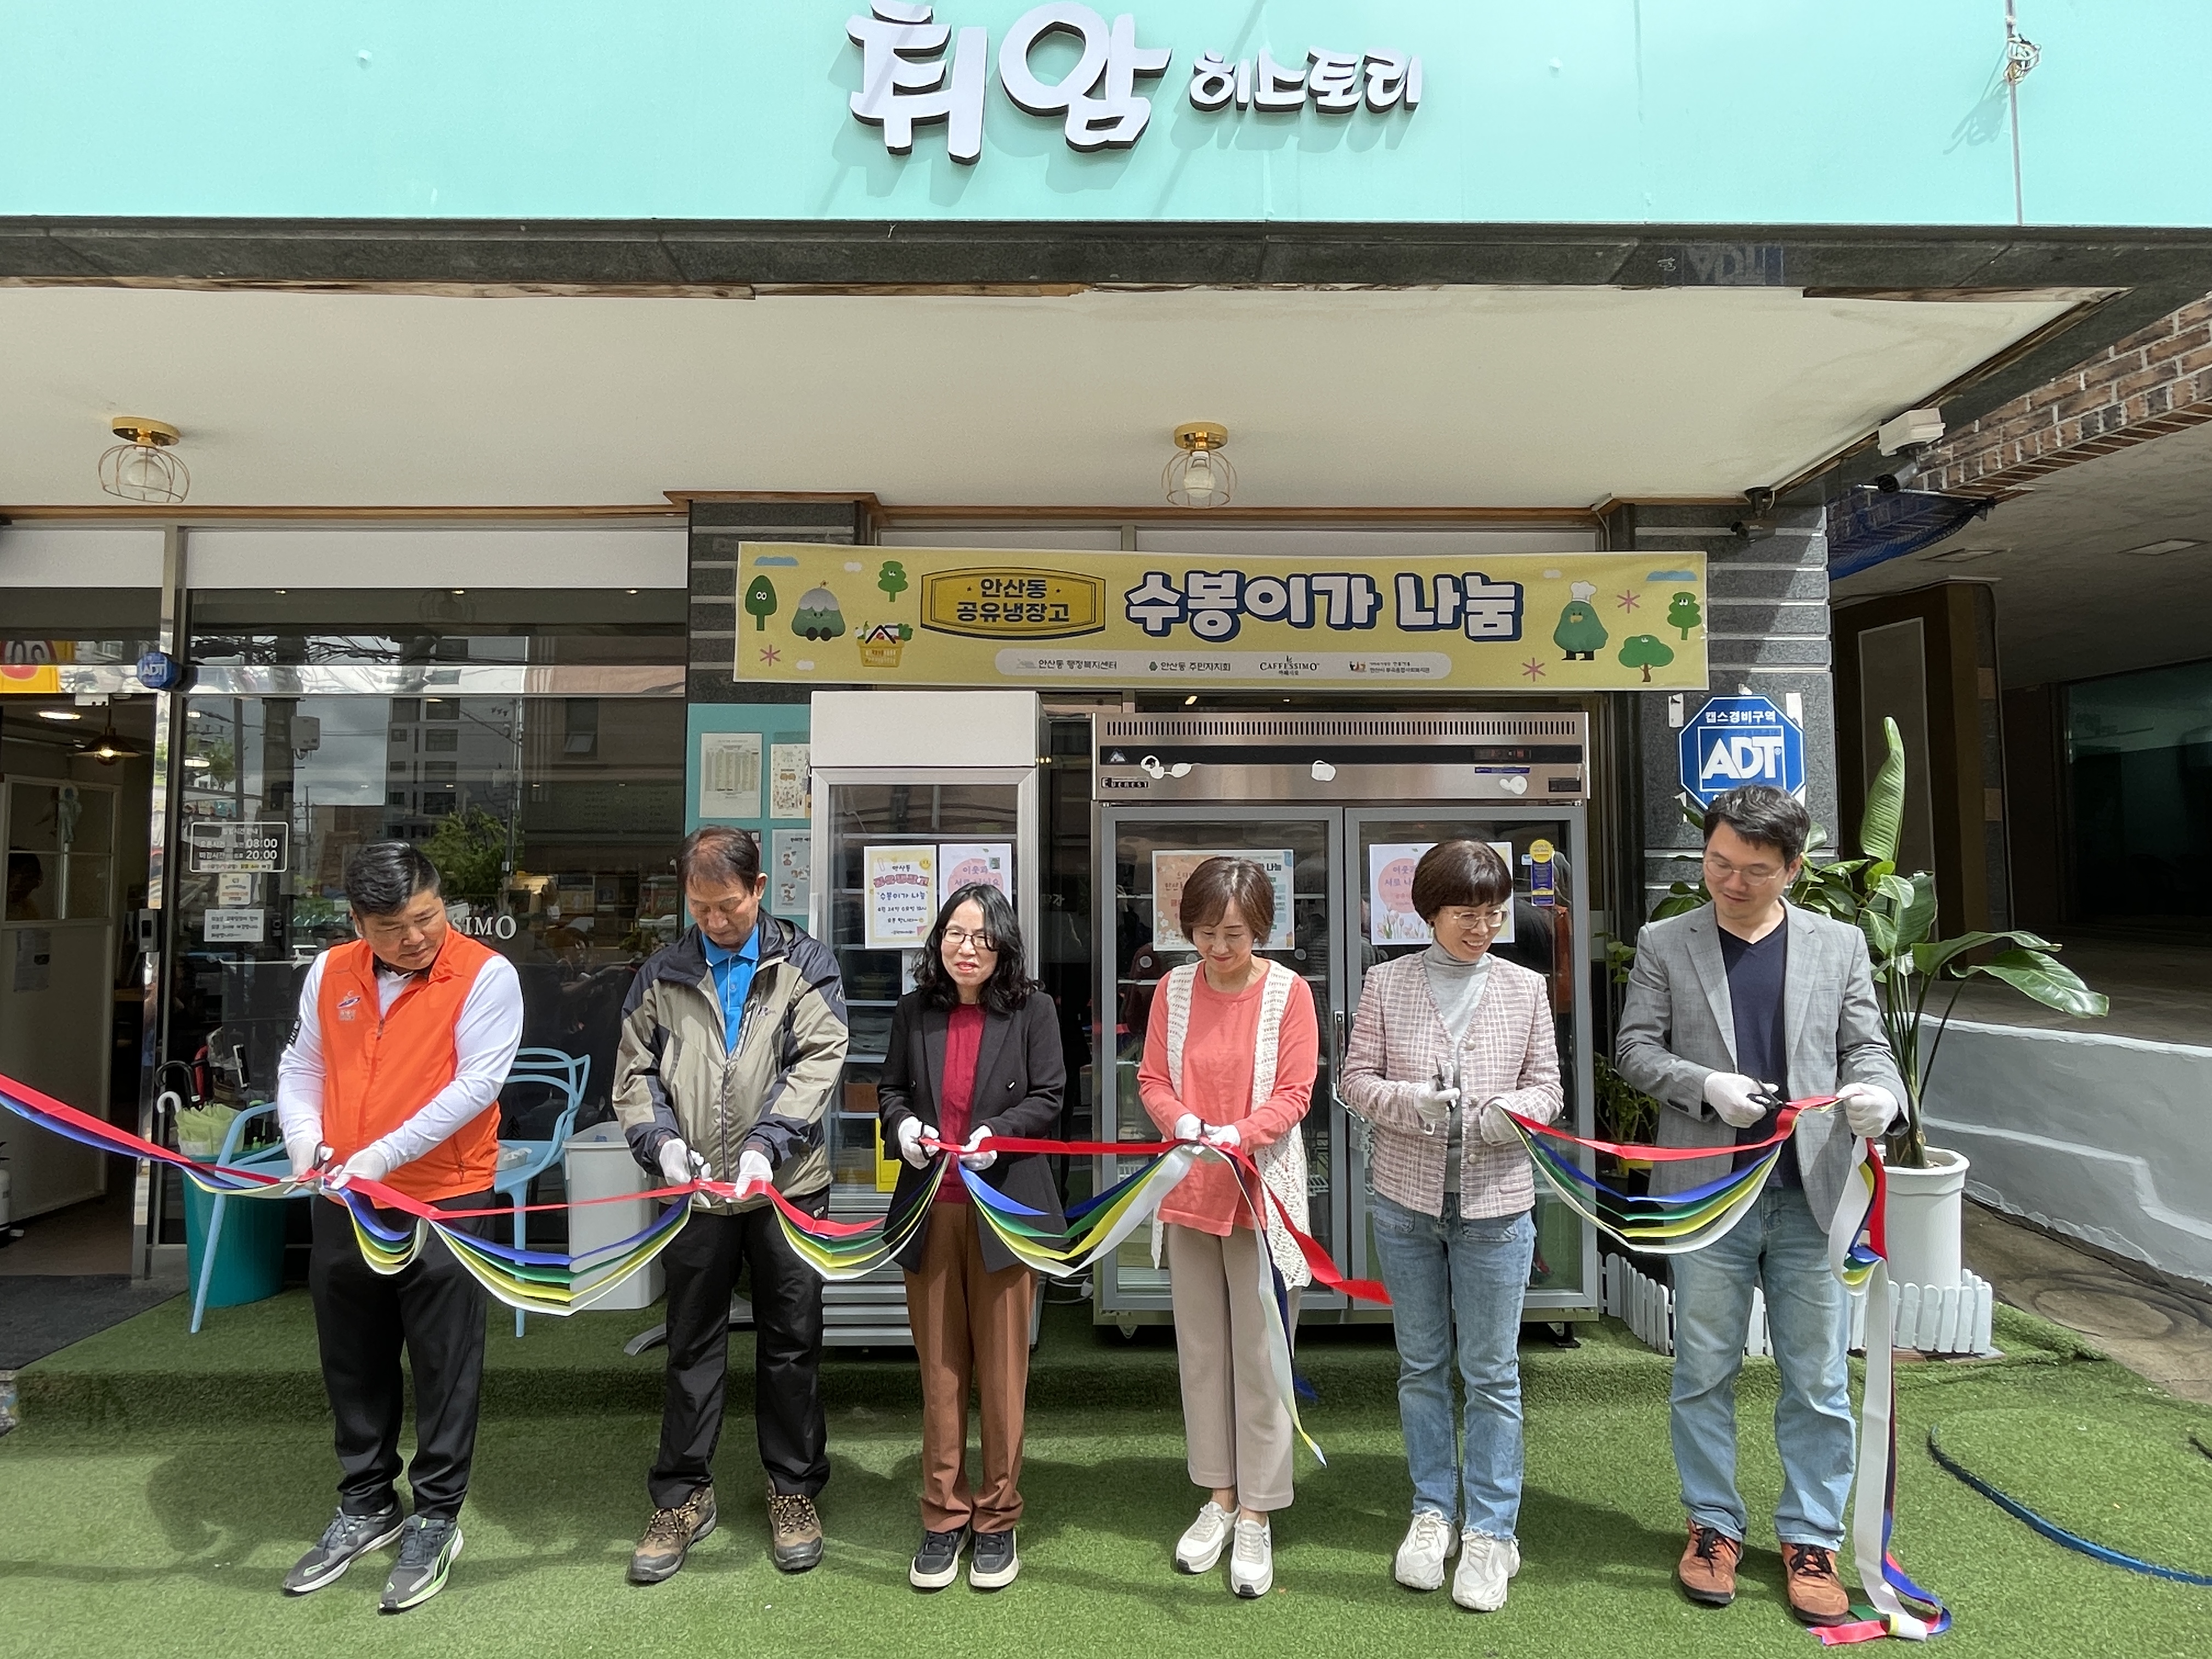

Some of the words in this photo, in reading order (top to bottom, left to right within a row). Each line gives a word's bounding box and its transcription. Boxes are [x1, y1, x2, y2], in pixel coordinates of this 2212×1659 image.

[1189, 46, 1423, 113] 히스토리
[980, 578, 1048, 599] 안산동
[956, 602, 1070, 624] 공유냉장고
[1125, 570, 1383, 642] 수봉이가
[1395, 573, 1524, 642] 나눔
[142, 664, 163, 676] ADT
[1038, 659, 1064, 669] 안산동
[1066, 659, 1117, 670] 행정복지센터
[1160, 662, 1186, 672] 안산동
[1189, 662, 1231, 672] 주민자치회
[1701, 736, 1782, 779] ADT
[246, 838, 278, 848] 08:00
[246, 850, 278, 860] 20:00
